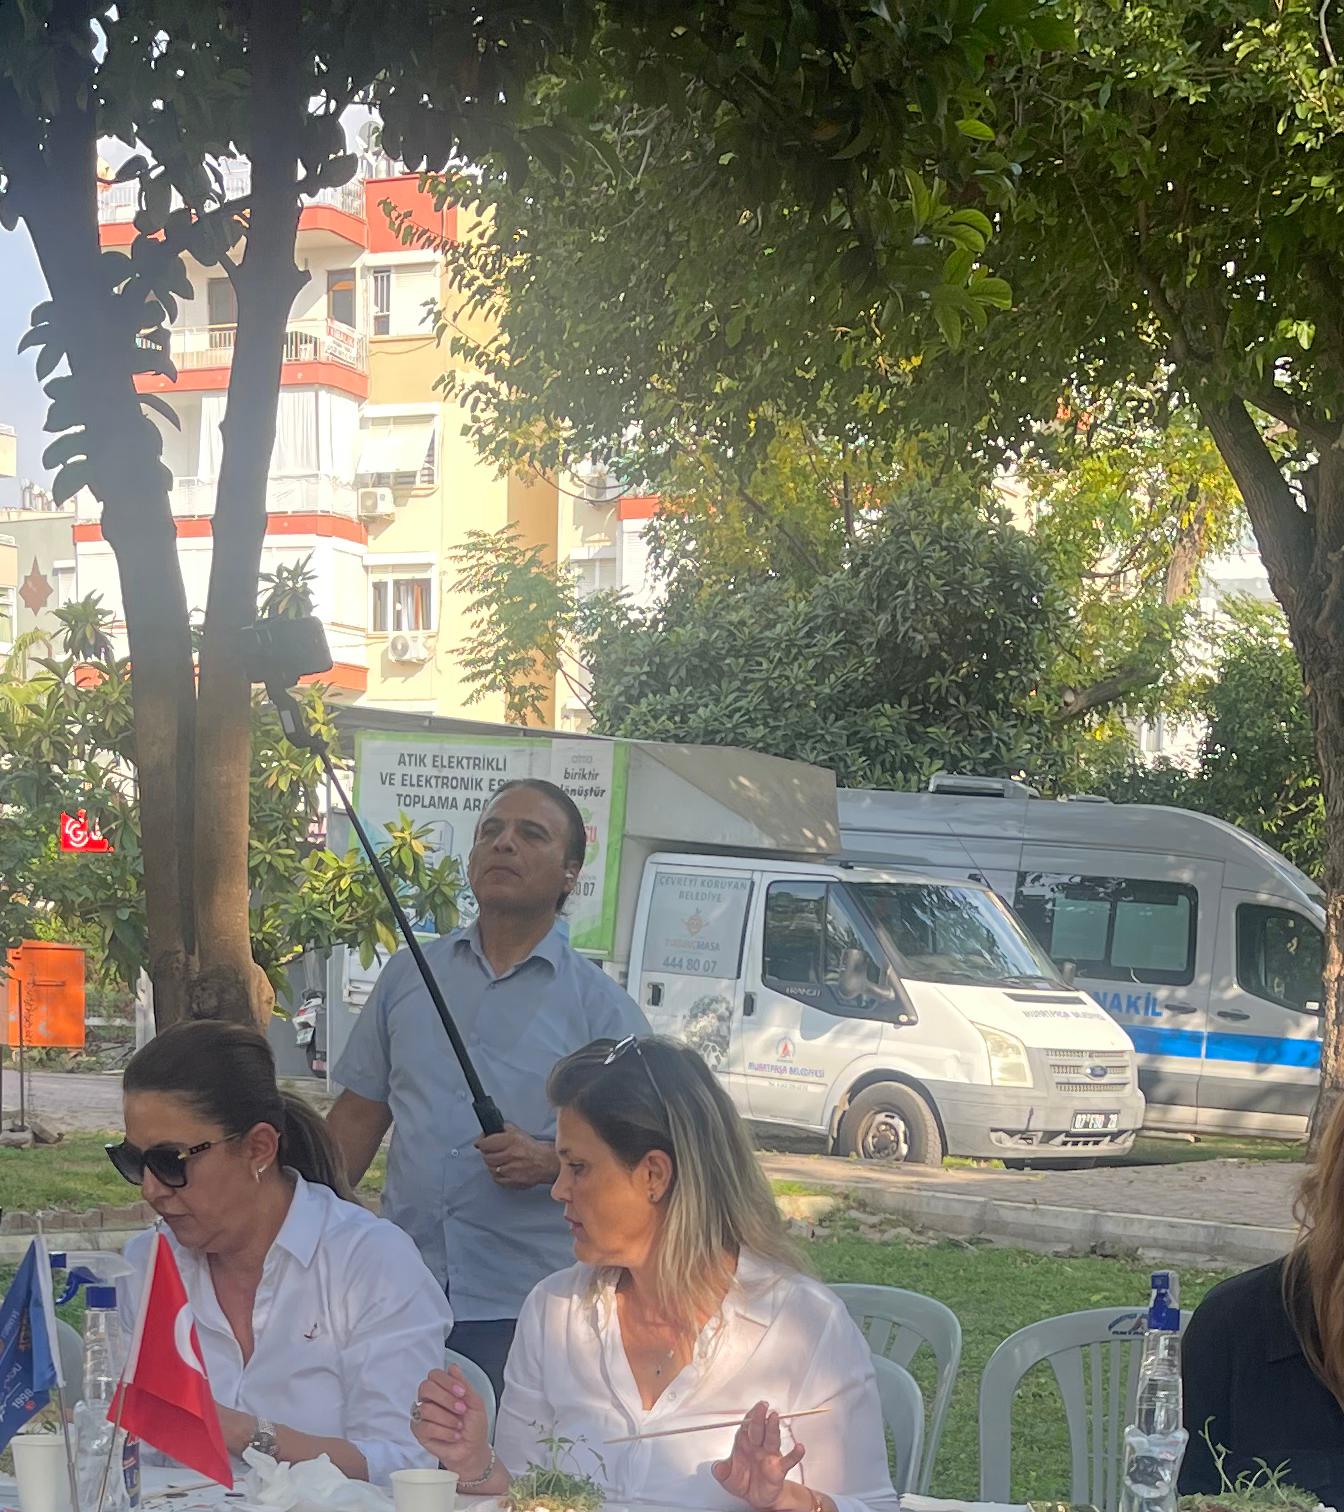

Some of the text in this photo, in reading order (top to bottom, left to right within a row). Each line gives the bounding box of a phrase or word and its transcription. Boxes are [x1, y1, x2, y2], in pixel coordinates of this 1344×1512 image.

[397, 753, 507, 772] ATIK ELEKTRİKLİ
[380, 772, 396, 786] VE
[401, 773, 484, 792] ELEKTRONİK
[563, 768, 600, 781] biriktir
[396, 793, 458, 811] TOPLAMA
[662, 956, 718, 973] 444 80 07
